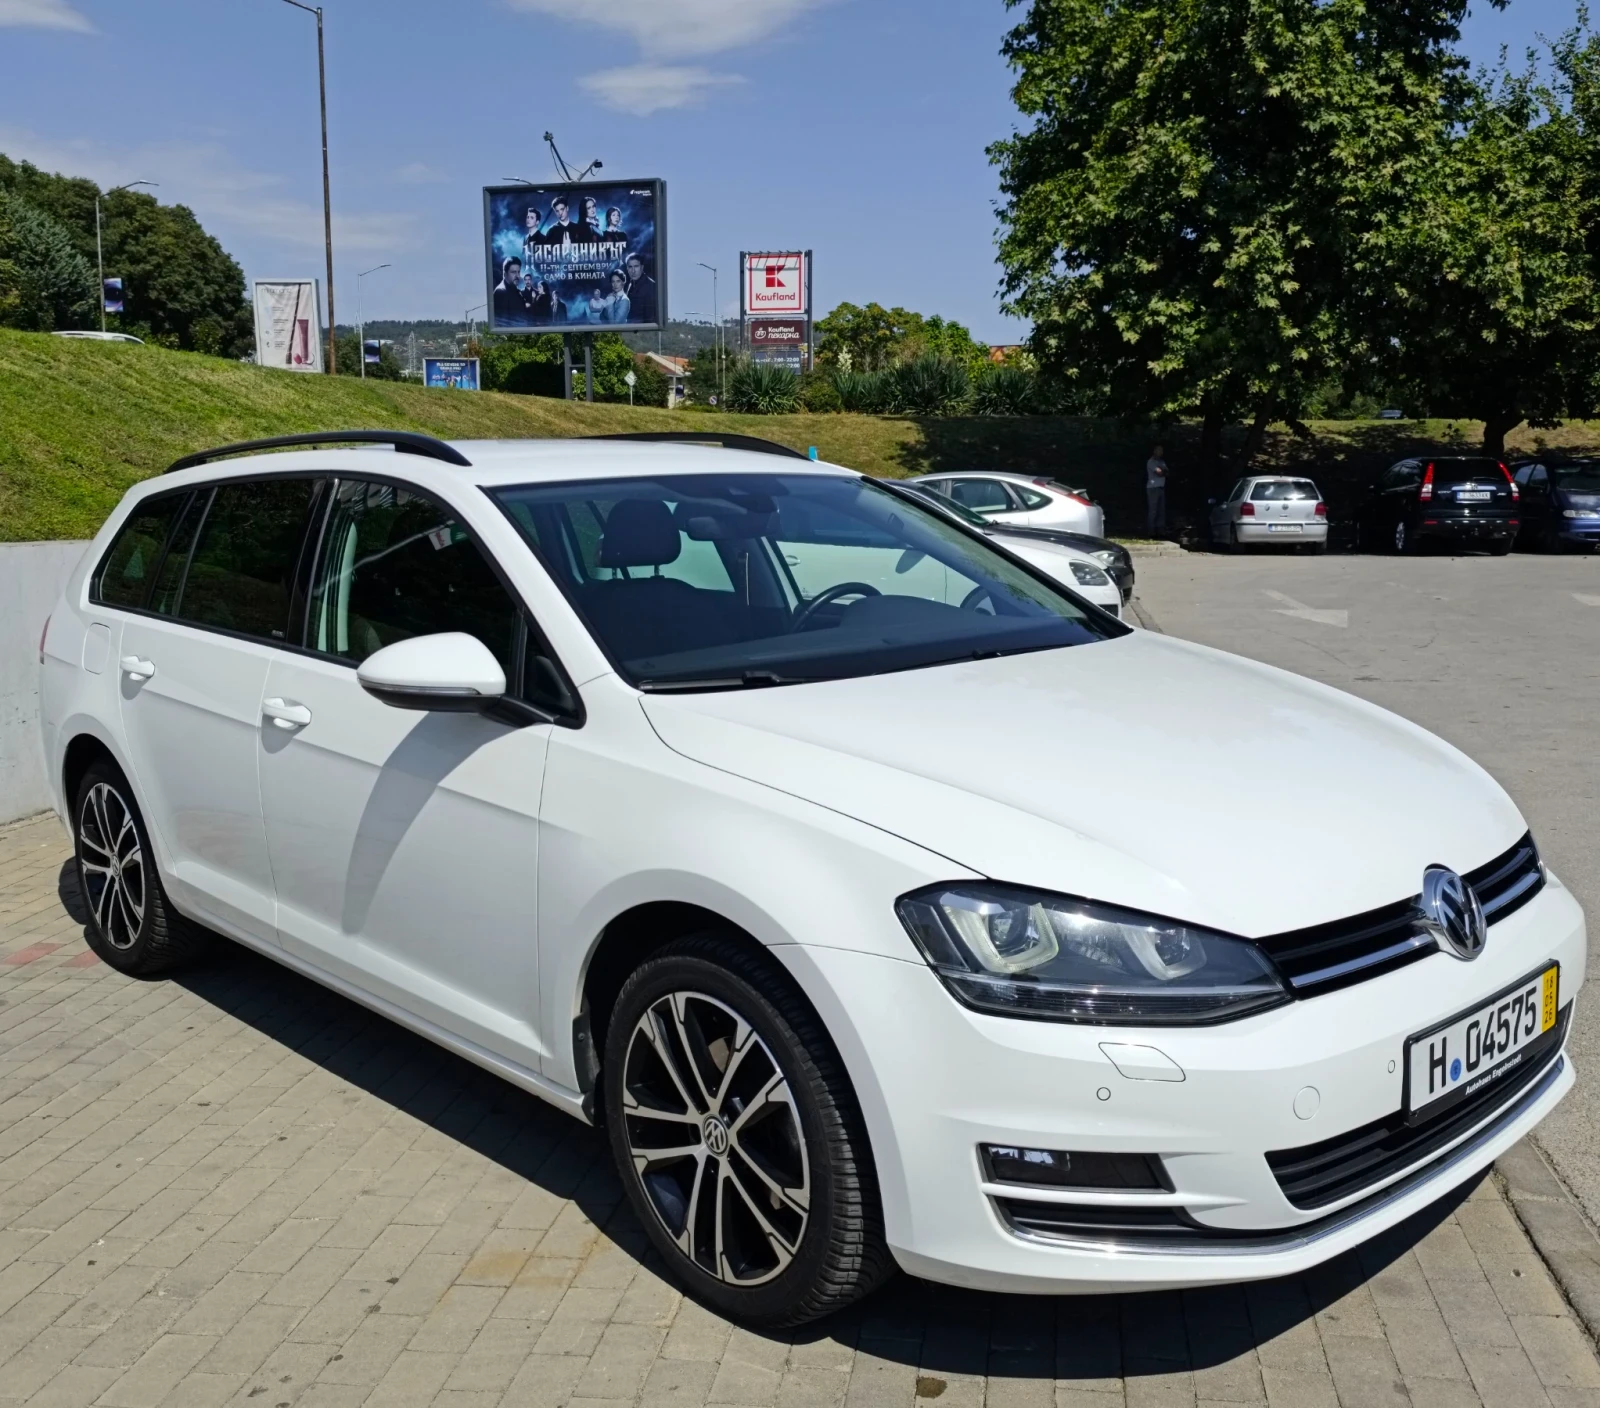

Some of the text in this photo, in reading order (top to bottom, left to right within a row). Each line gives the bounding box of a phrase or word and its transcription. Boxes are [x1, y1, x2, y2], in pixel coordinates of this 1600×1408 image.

[562, 263, 612, 272] СЕПТЕМВРИ
[755, 292, 796, 301] Kaufland
[1429, 985, 1537, 1094] H 04575
[1465, 1074, 1492, 1096] Autohaus
